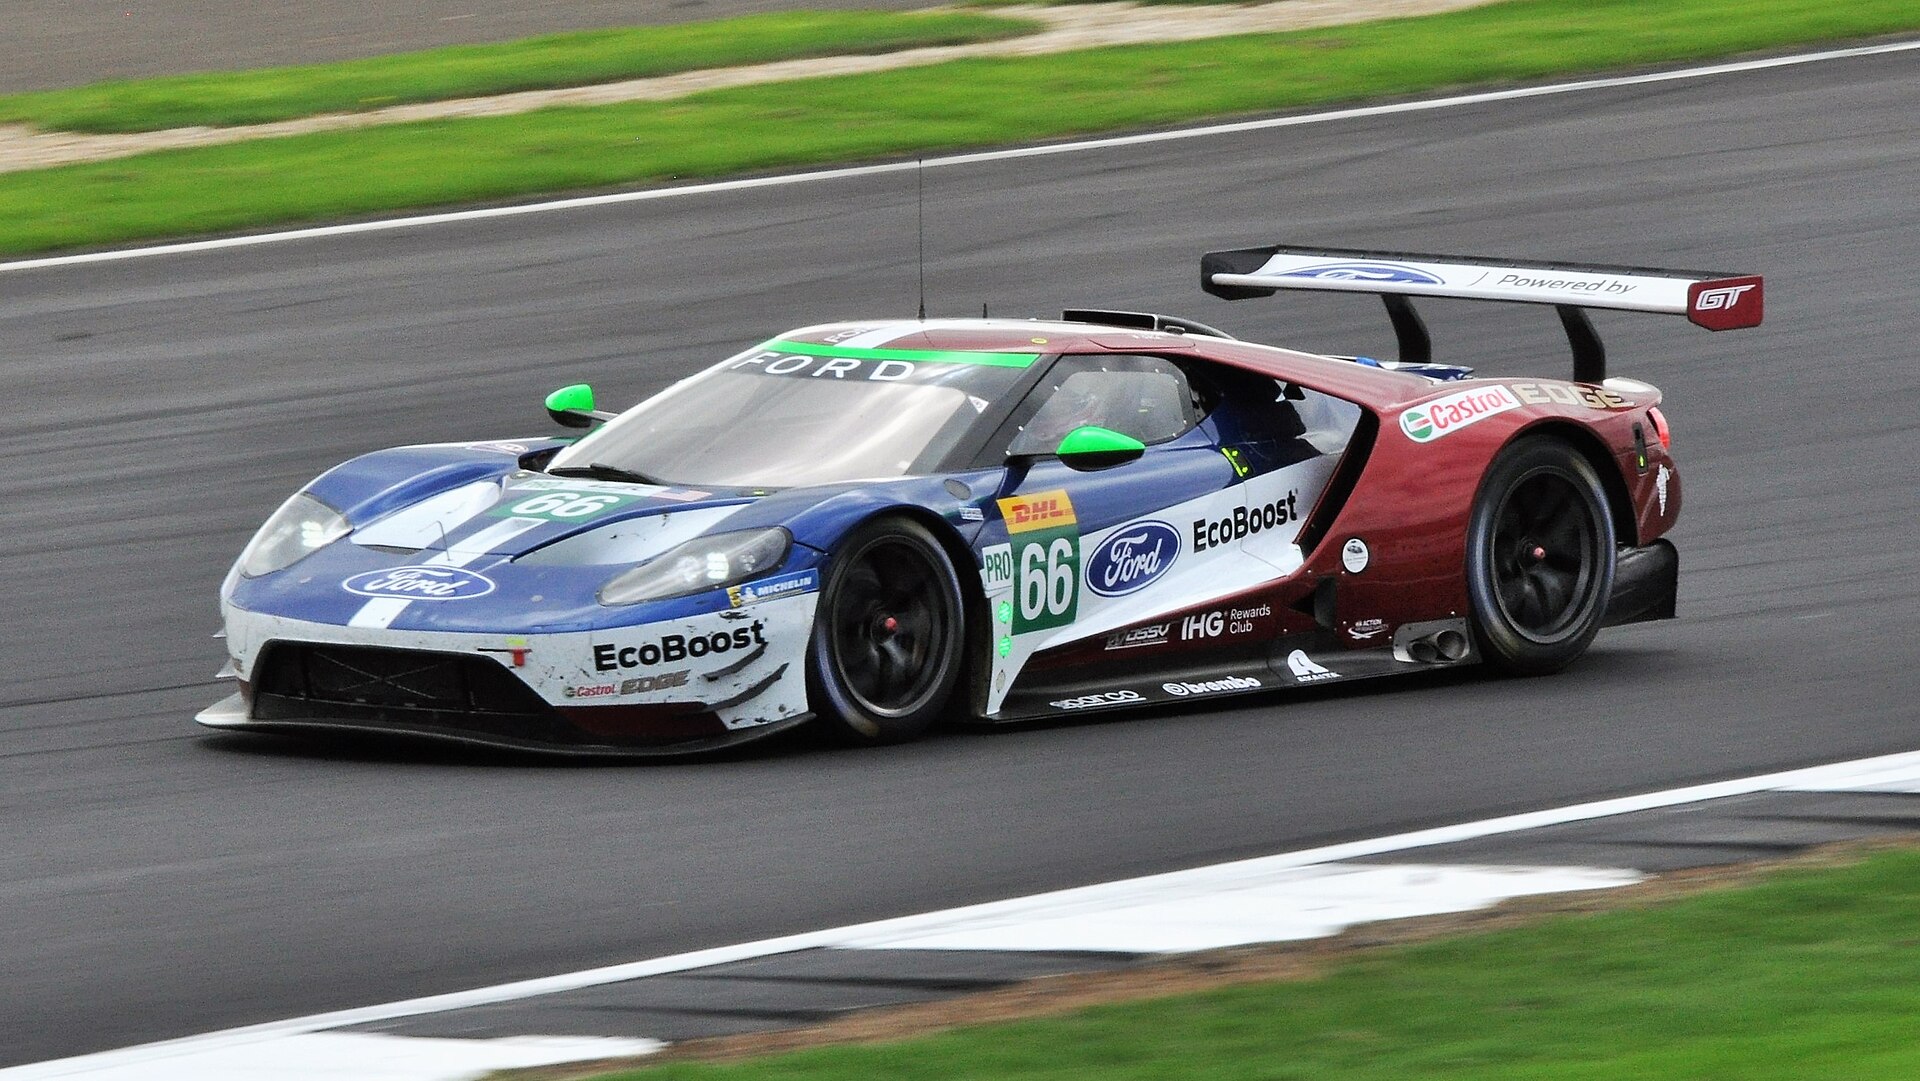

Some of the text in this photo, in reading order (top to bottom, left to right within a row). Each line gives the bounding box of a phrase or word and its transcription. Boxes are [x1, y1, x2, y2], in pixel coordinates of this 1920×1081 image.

[1496, 274, 1638, 294] Powered by
[1695, 284, 1756, 311] GT
[732, 352, 915, 382] FORD
[1429, 383, 1636, 430] Castrol EDGE
[511, 492, 621, 518] 66
[1011, 499, 1064, 524] DHL
[1193, 489, 1299, 554] EcoBoost
[985, 551, 1011, 583] PRO
[1104, 532, 1163, 588] Ford
[364, 568, 470, 597] Ford
[757, 577, 812, 596] MICHELIN
[1020, 537, 1074, 621] 66
[1181, 611, 1225, 641] IHG
[1230, 604, 1272, 621] Rewards
[1229, 620, 1254, 635] Club
[593, 619, 766, 671] EcoBoost
[576, 669, 691, 697] Castrol EDGE
[1185, 675, 1262, 695] brembo
[1049, 690, 1141, 709] sparco
